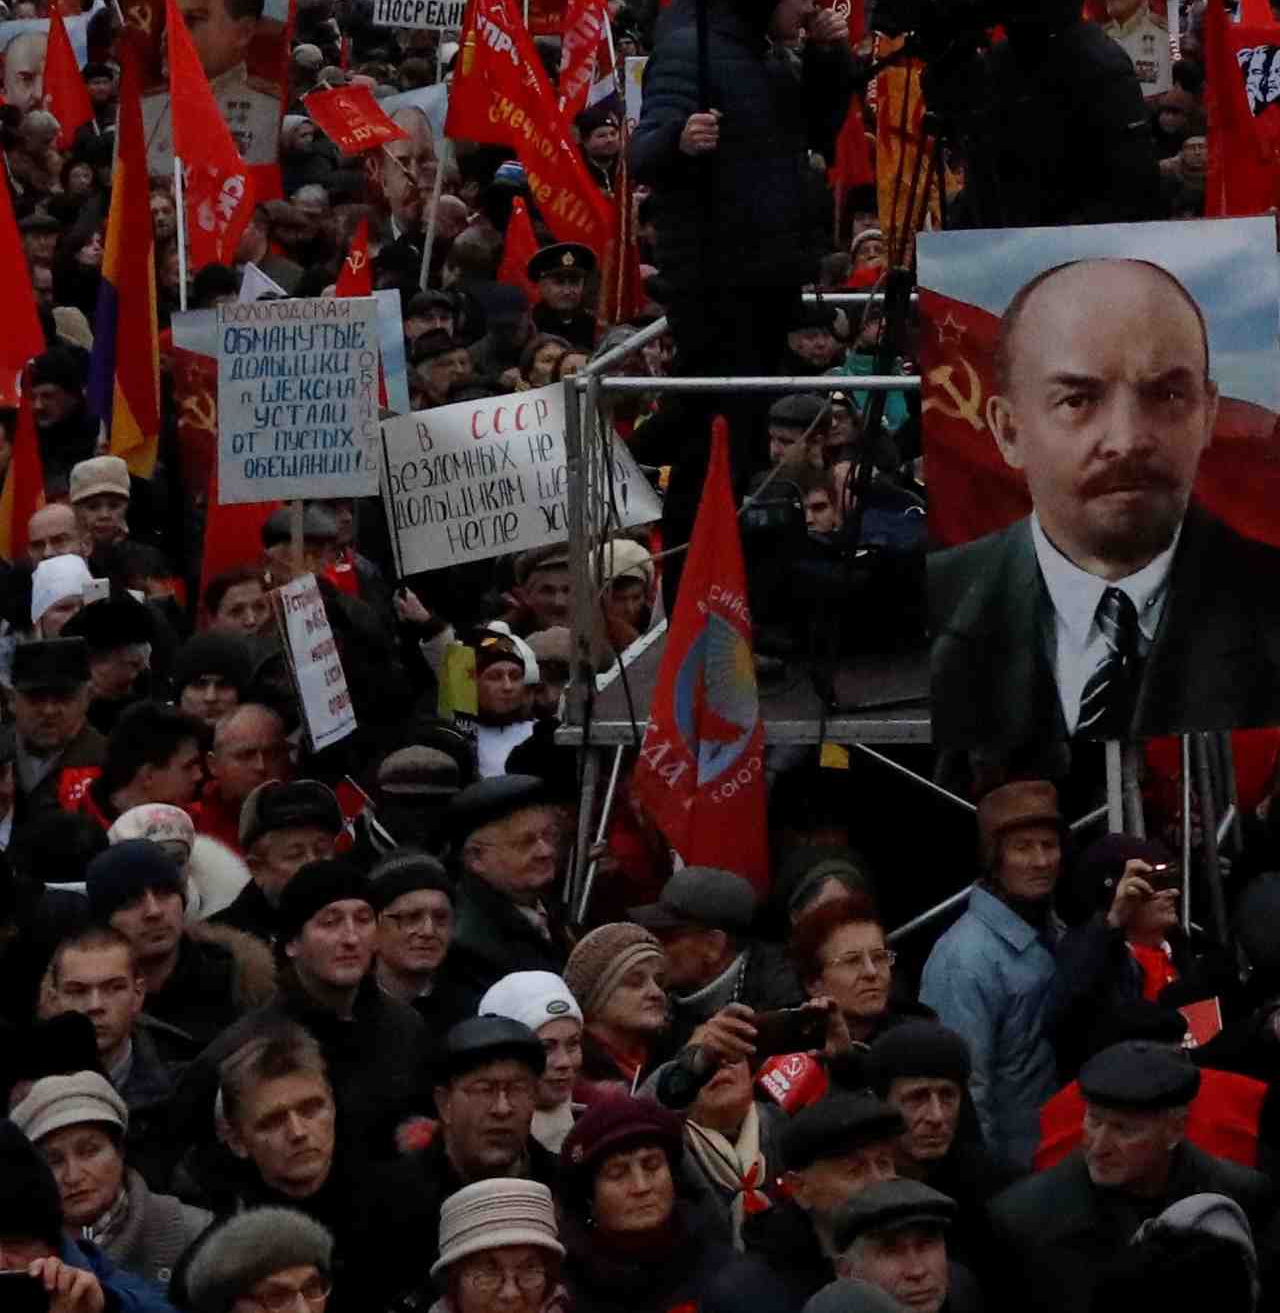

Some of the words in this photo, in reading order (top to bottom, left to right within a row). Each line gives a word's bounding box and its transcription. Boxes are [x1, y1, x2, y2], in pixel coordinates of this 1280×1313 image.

[224, 322, 366, 354] ОБМАНУТЫЕ
[261, 377, 356, 403] ШЕКСНА
[255, 403, 346, 429] УСТАЛИ
[416, 422, 433, 453] В
[471, 398, 549, 439] СССР
[232, 433, 256, 454] ОТ
[274, 429, 354, 451] ПУСТЫХ
